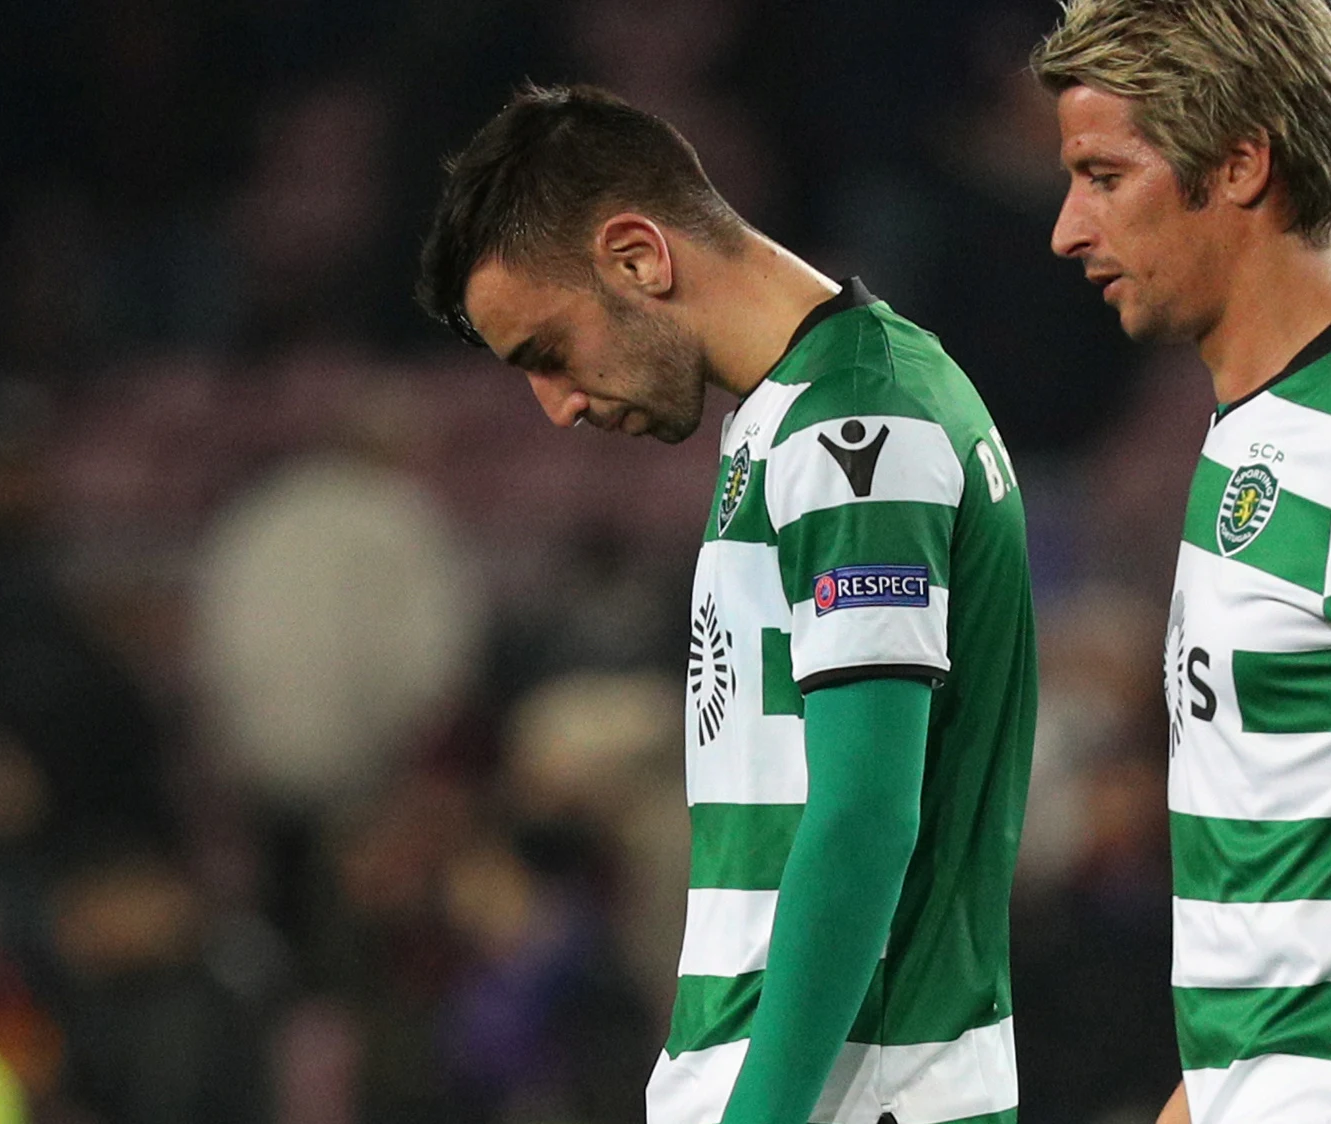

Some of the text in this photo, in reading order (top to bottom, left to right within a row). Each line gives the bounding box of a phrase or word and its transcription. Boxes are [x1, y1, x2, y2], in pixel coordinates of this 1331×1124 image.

[1248, 442, 1285, 464] SCP
[1234, 468, 1274, 498] SPORTING
[837, 576, 928, 597] RESPECT
